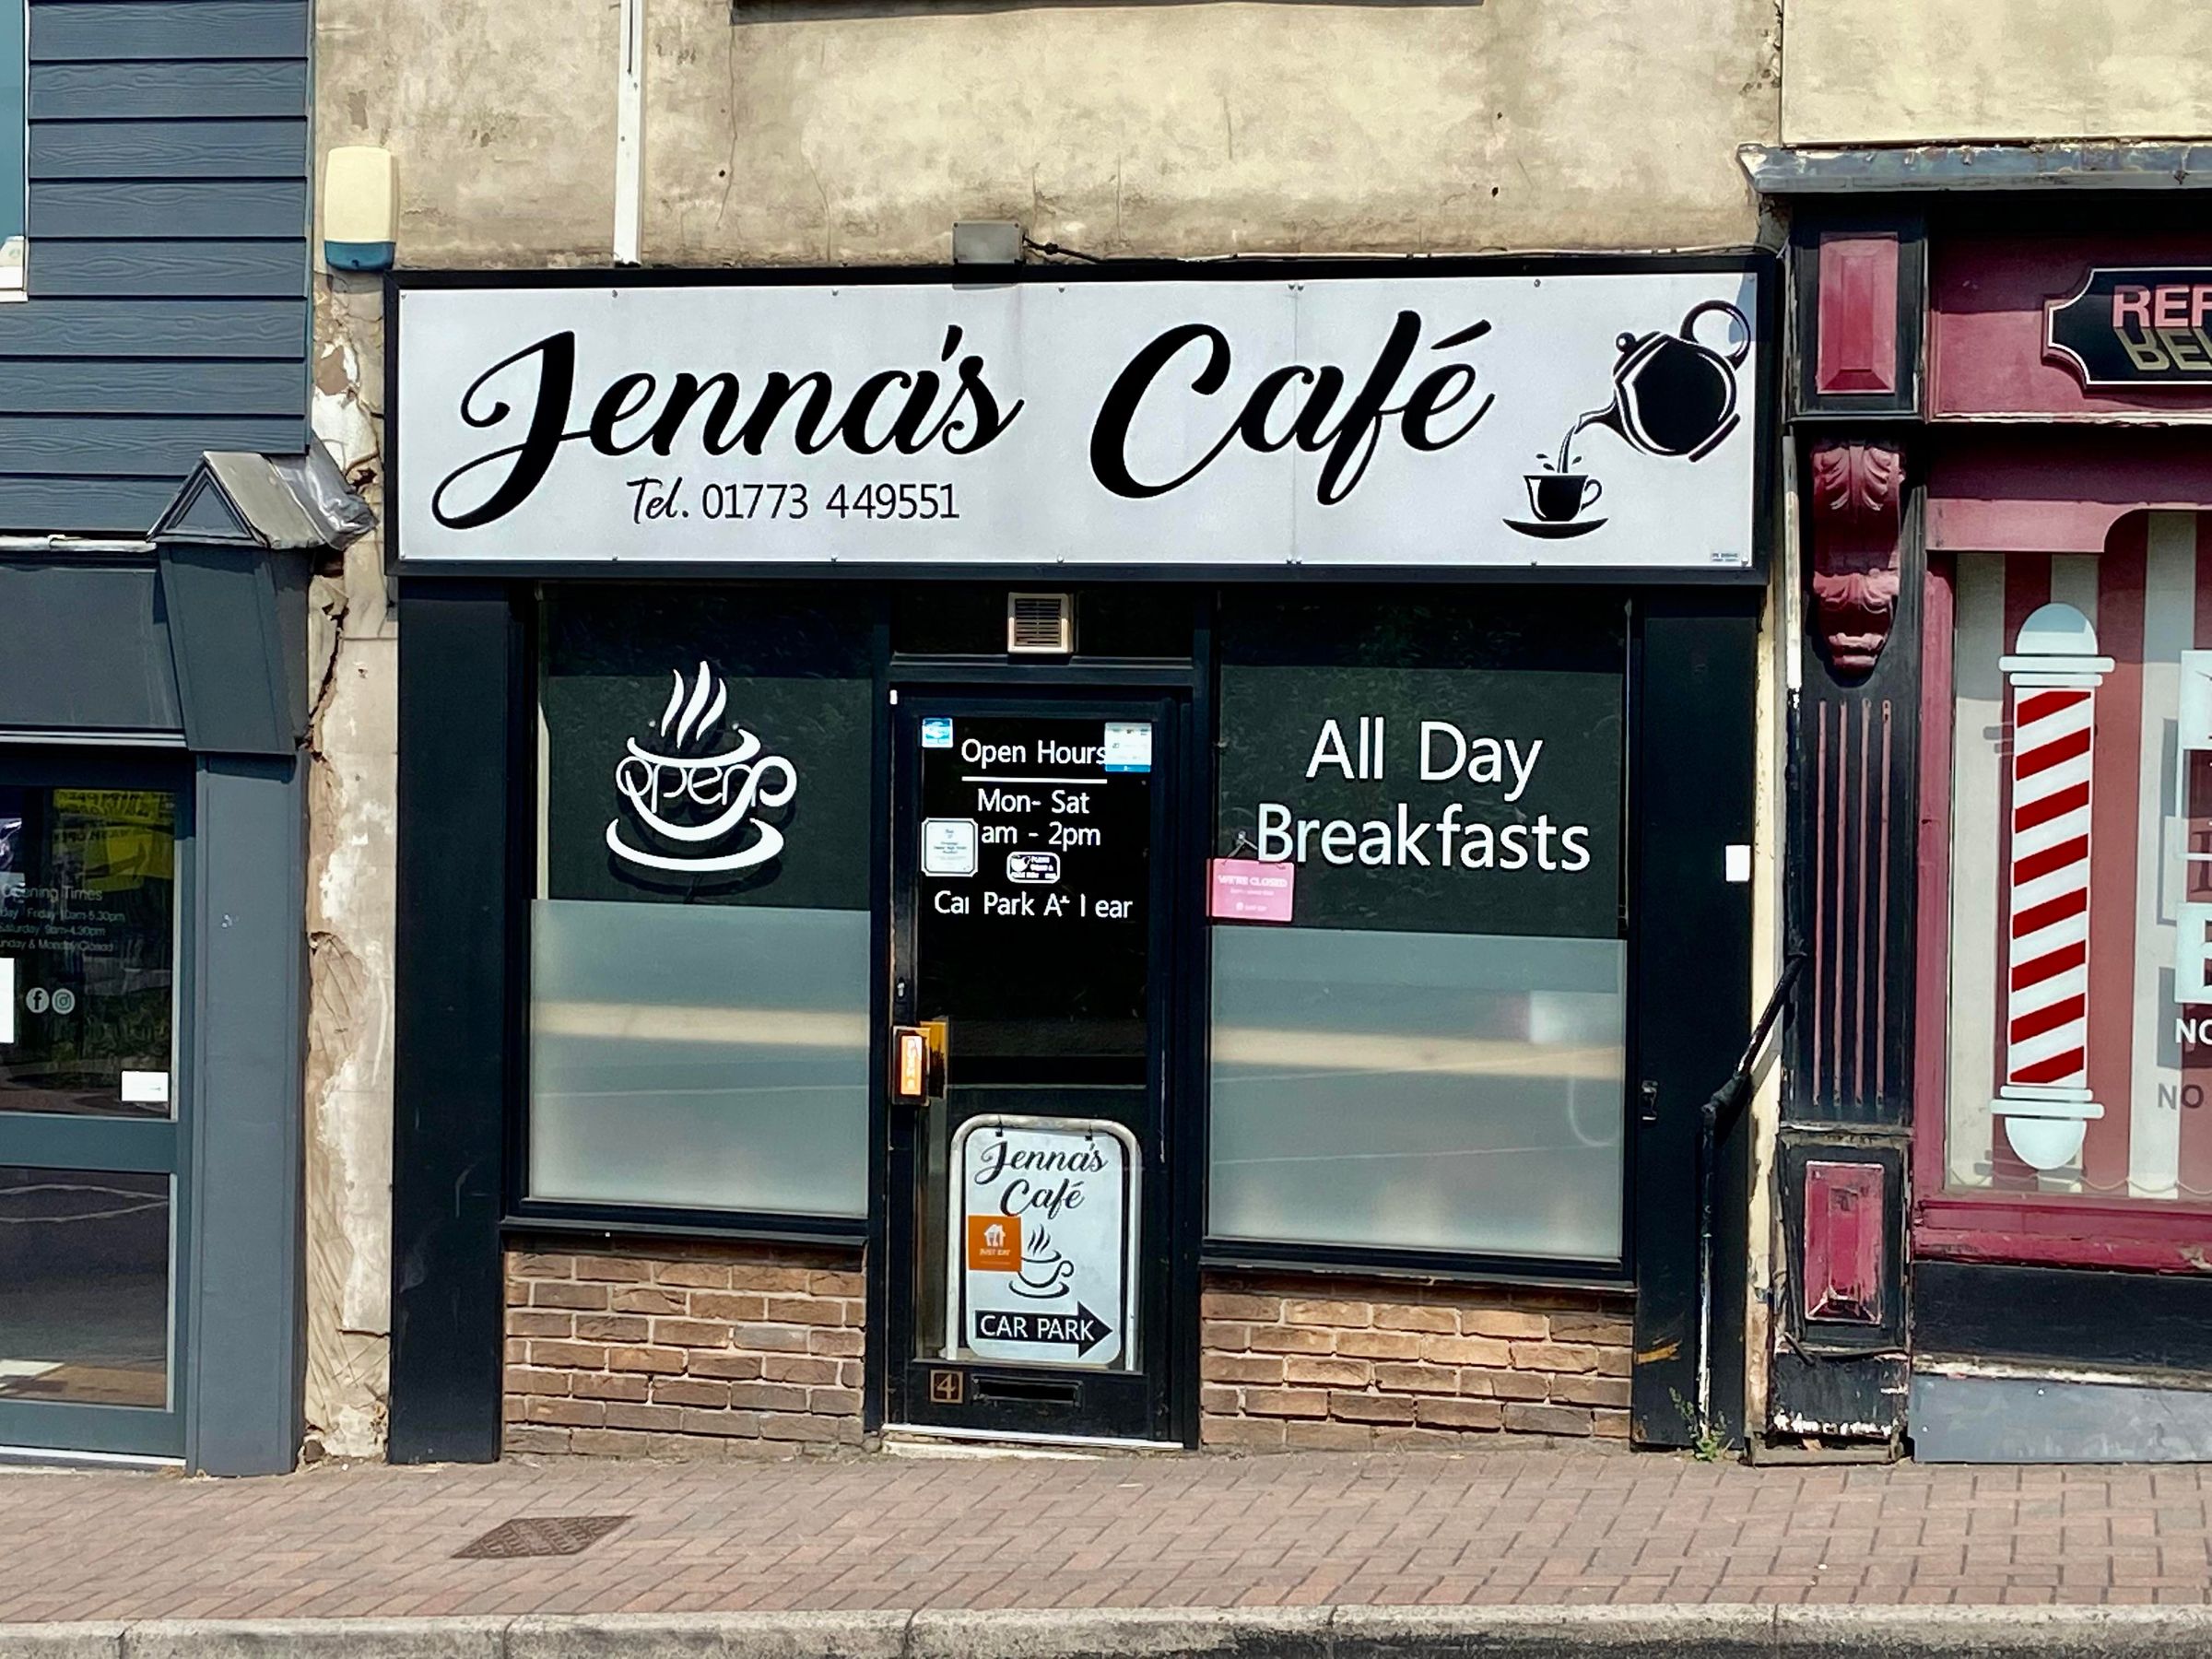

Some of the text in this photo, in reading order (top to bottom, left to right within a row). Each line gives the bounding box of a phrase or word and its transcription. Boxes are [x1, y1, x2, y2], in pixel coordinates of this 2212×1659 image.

[432, 310, 1495, 530] Jenna's Café
[627, 476, 960, 524] Tel. 01773 449551
[961, 738, 1027, 769] Open
[1037, 740, 1107, 766] Hours
[1305, 715, 1544, 802] All Day
[977, 788, 1090, 815] Mon- Sat
[981, 825, 1018, 845] am
[1048, 820, 1101, 852] 2pm
[1257, 802, 1591, 871] Breakfasts
[983, 890, 1035, 916] Park
[974, 1141, 1109, 1185] Jenna's
[1000, 1177, 1085, 1220] Café
[980, 1314, 1095, 1342] CAR PARK
[935, 1374, 957, 1400] 4
